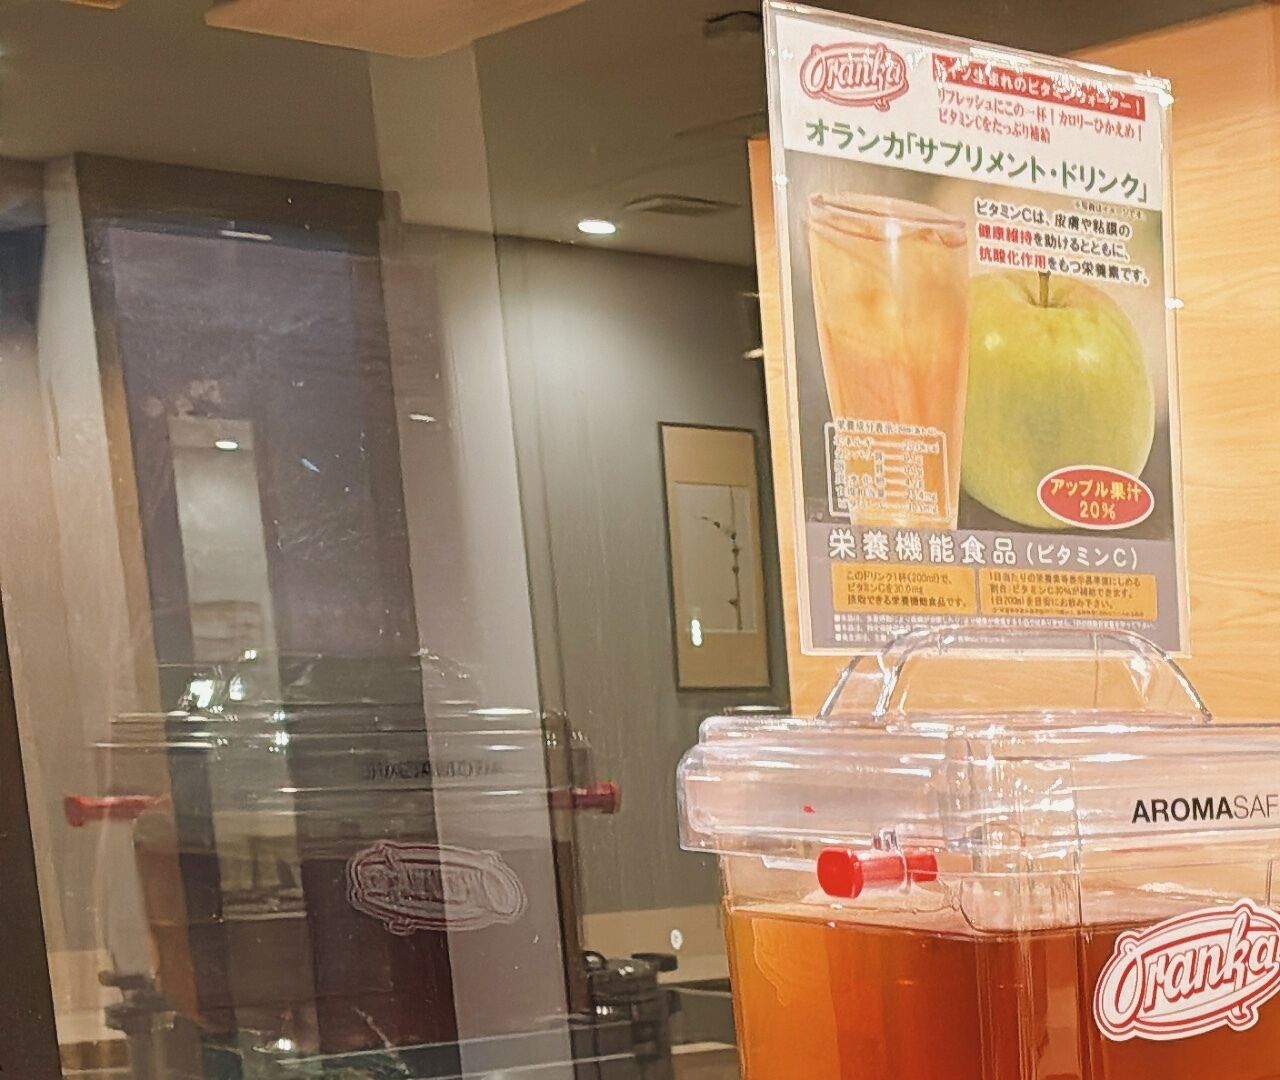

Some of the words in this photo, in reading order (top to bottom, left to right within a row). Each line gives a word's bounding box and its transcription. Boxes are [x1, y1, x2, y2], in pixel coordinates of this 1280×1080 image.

[804, 42, 907, 97] Oranka
[805, 118, 1148, 204] オランカ「サプリメント・ドリンク」
[975, 199, 1131, 238] ビタミンCは、皮膚や粘膜の
[977, 223, 1130, 261] 健康維持を助けるとともに、
[978, 247, 1150, 285] 抗酸化作用をもつ栄養素です。
[1050, 478, 1143, 503] アップル果汁
[1079, 500, 1117, 521] 20%
